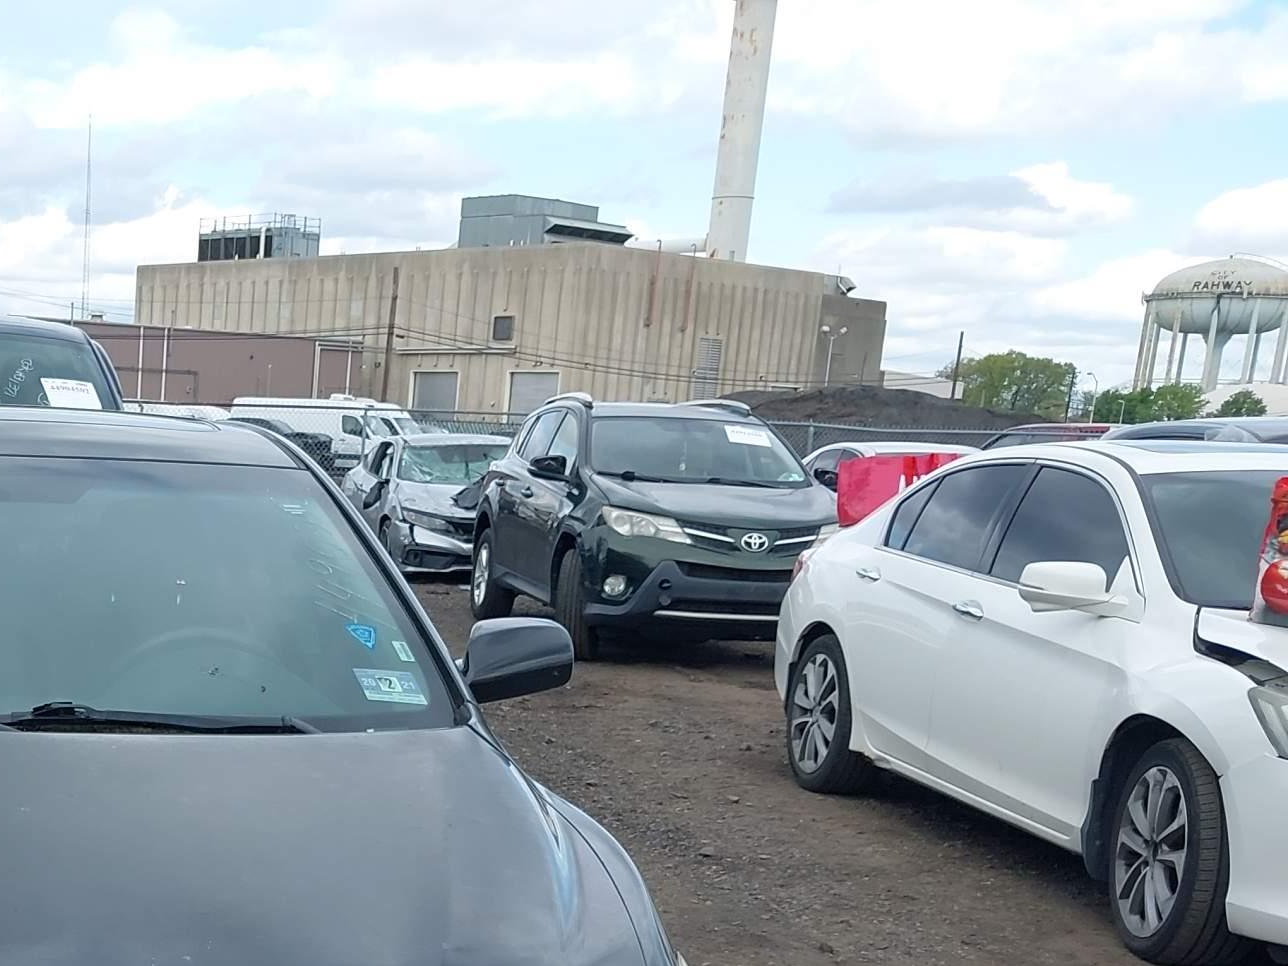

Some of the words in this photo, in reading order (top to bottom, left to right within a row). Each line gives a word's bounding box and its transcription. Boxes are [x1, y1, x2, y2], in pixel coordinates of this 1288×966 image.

[1192, 281, 1253, 291] RAHWAY
[361, 678, 377, 687] 20
[400, 681, 416, 690] 21
